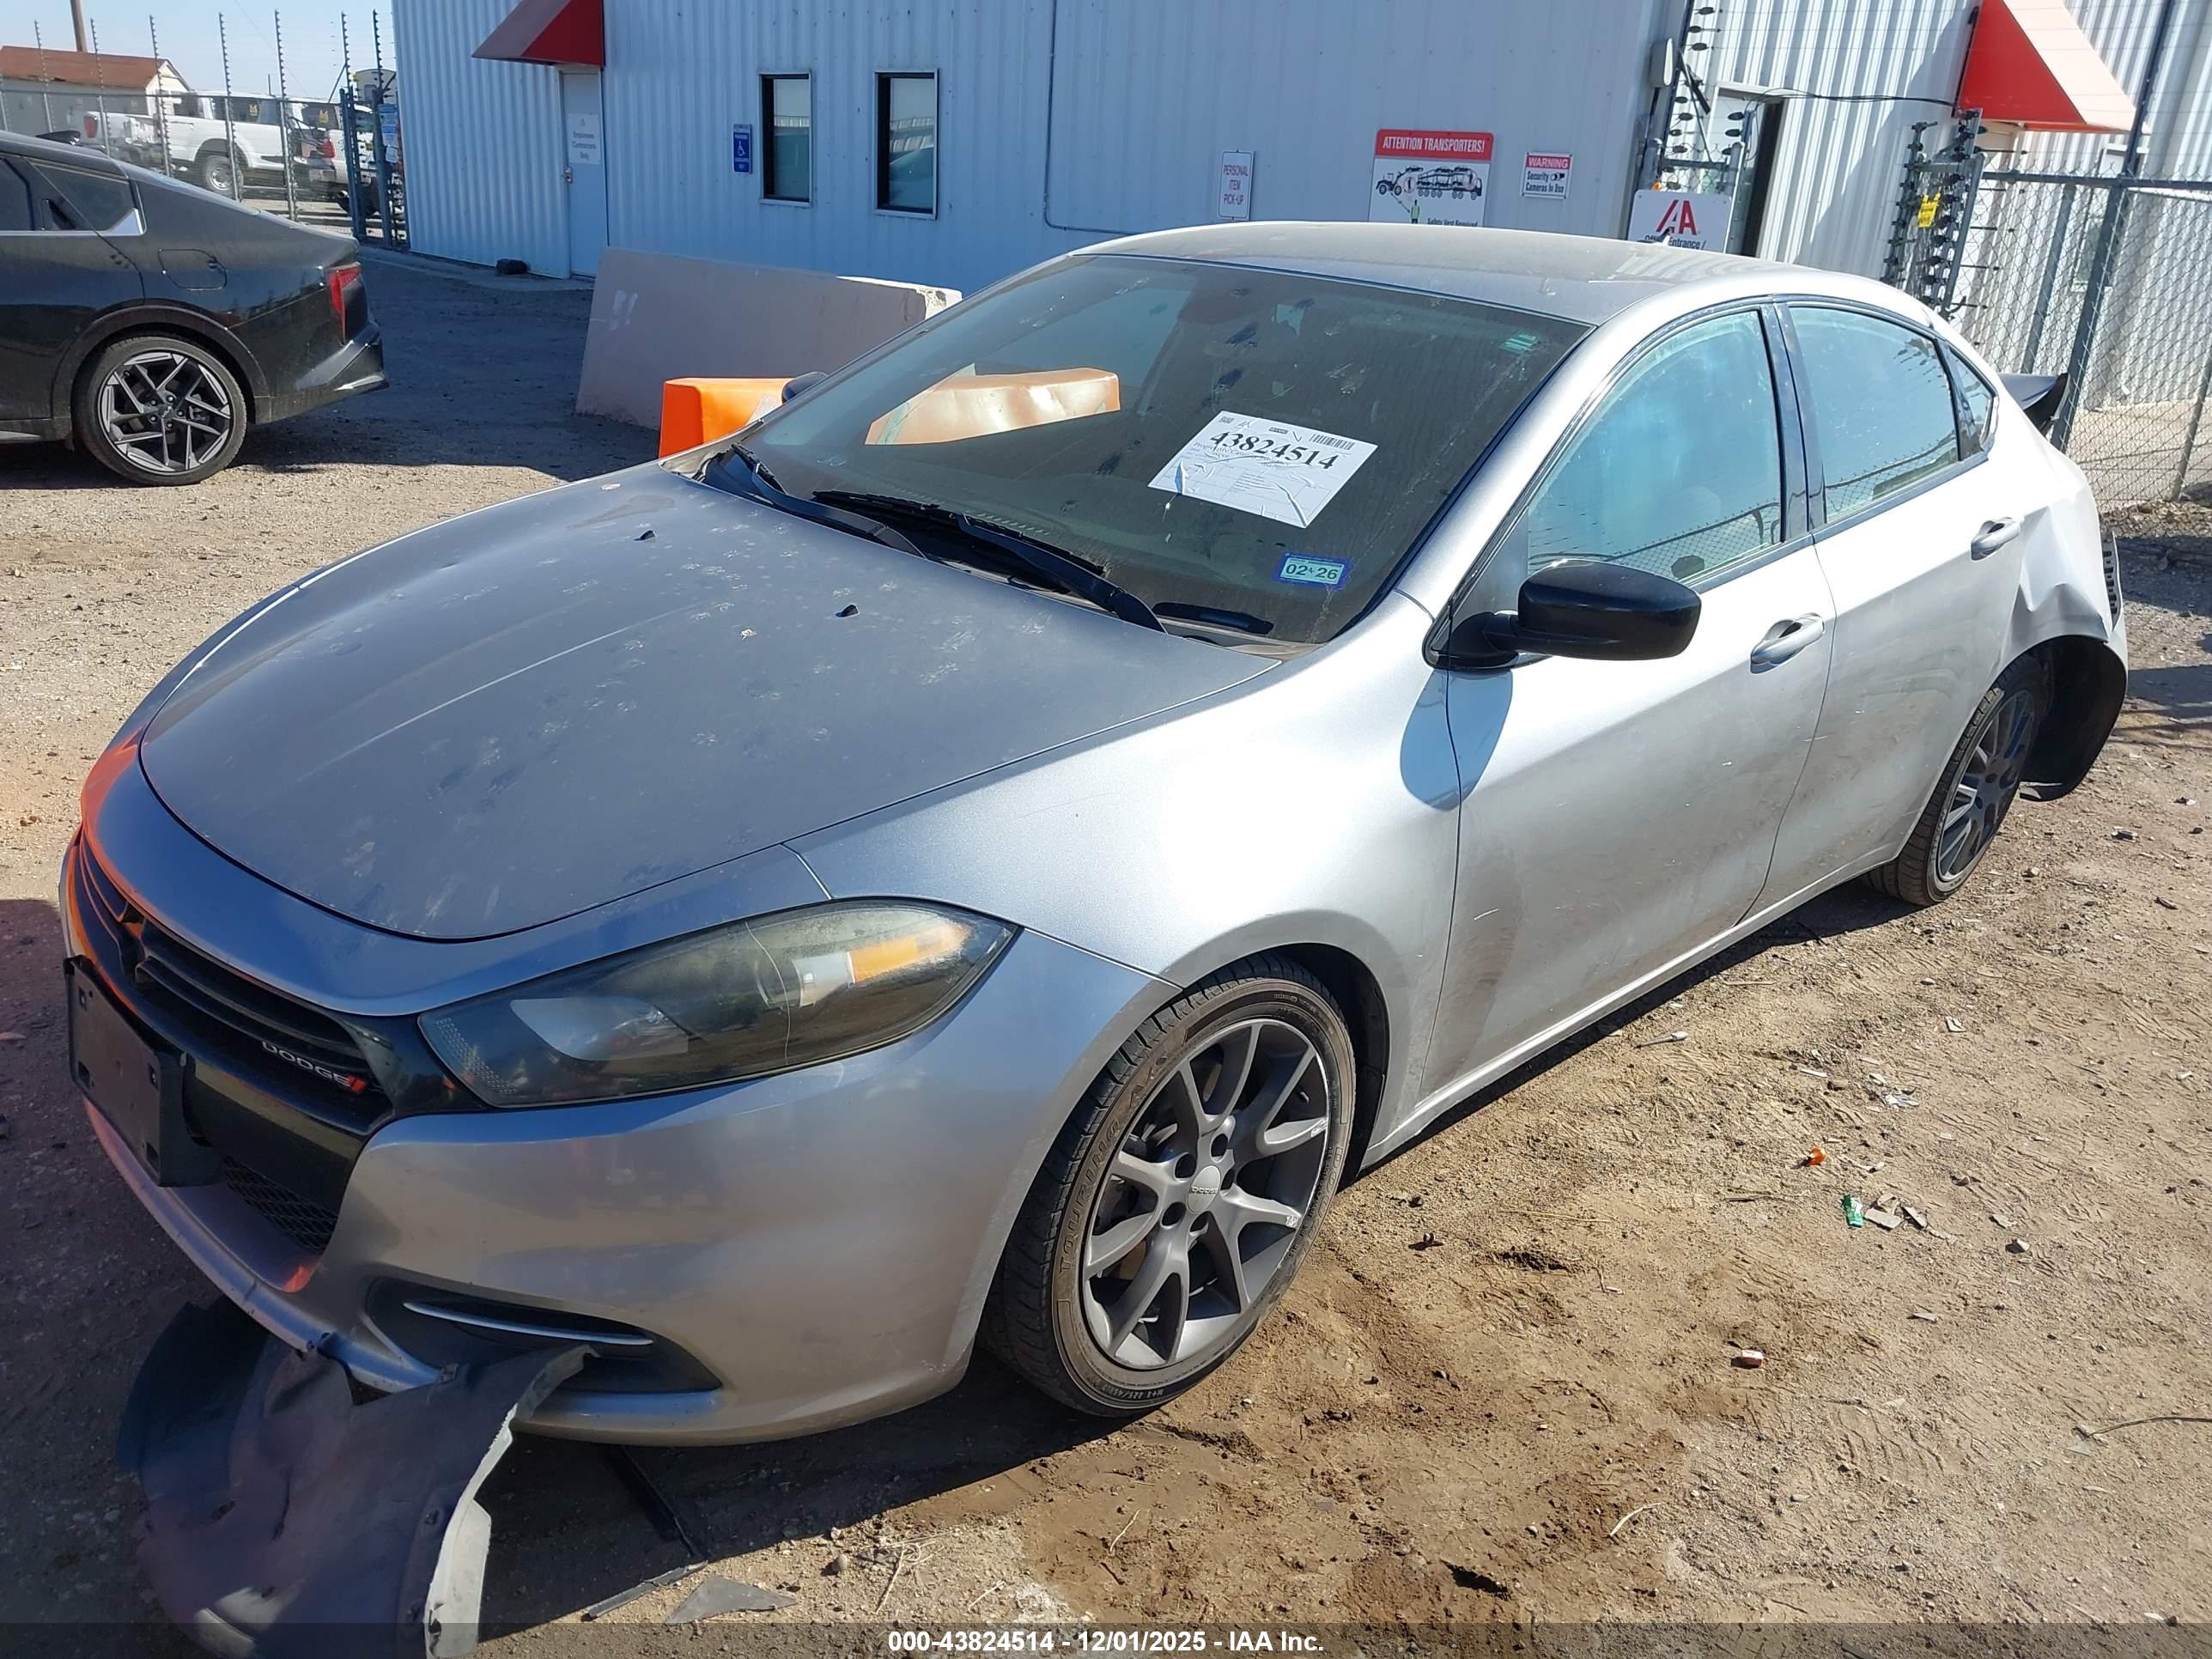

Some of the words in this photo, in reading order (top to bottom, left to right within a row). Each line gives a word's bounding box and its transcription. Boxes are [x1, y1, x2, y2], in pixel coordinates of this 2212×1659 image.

[1382, 136, 1423, 150] ATTENTION
[1424, 137, 1486, 153] TRANSPORTERS!
[1528, 157, 1569, 168] WARNING
[1223, 164, 1249, 177] PERSONAL
[1527, 171, 1549, 182] Security
[1229, 179, 1242, 191] ITEM
[1525, 182, 1547, 192] Cameras
[1554, 183, 1565, 193] Use
[1223, 193, 1244, 205] PICK-UP
[1209, 431, 1340, 470] 43824514
[1285, 563, 1309, 576] 02
[1316, 567, 1339, 580] 26
[262, 1041, 352, 1088] DODGE
[1059, 1118, 1121, 1275] TOURING
